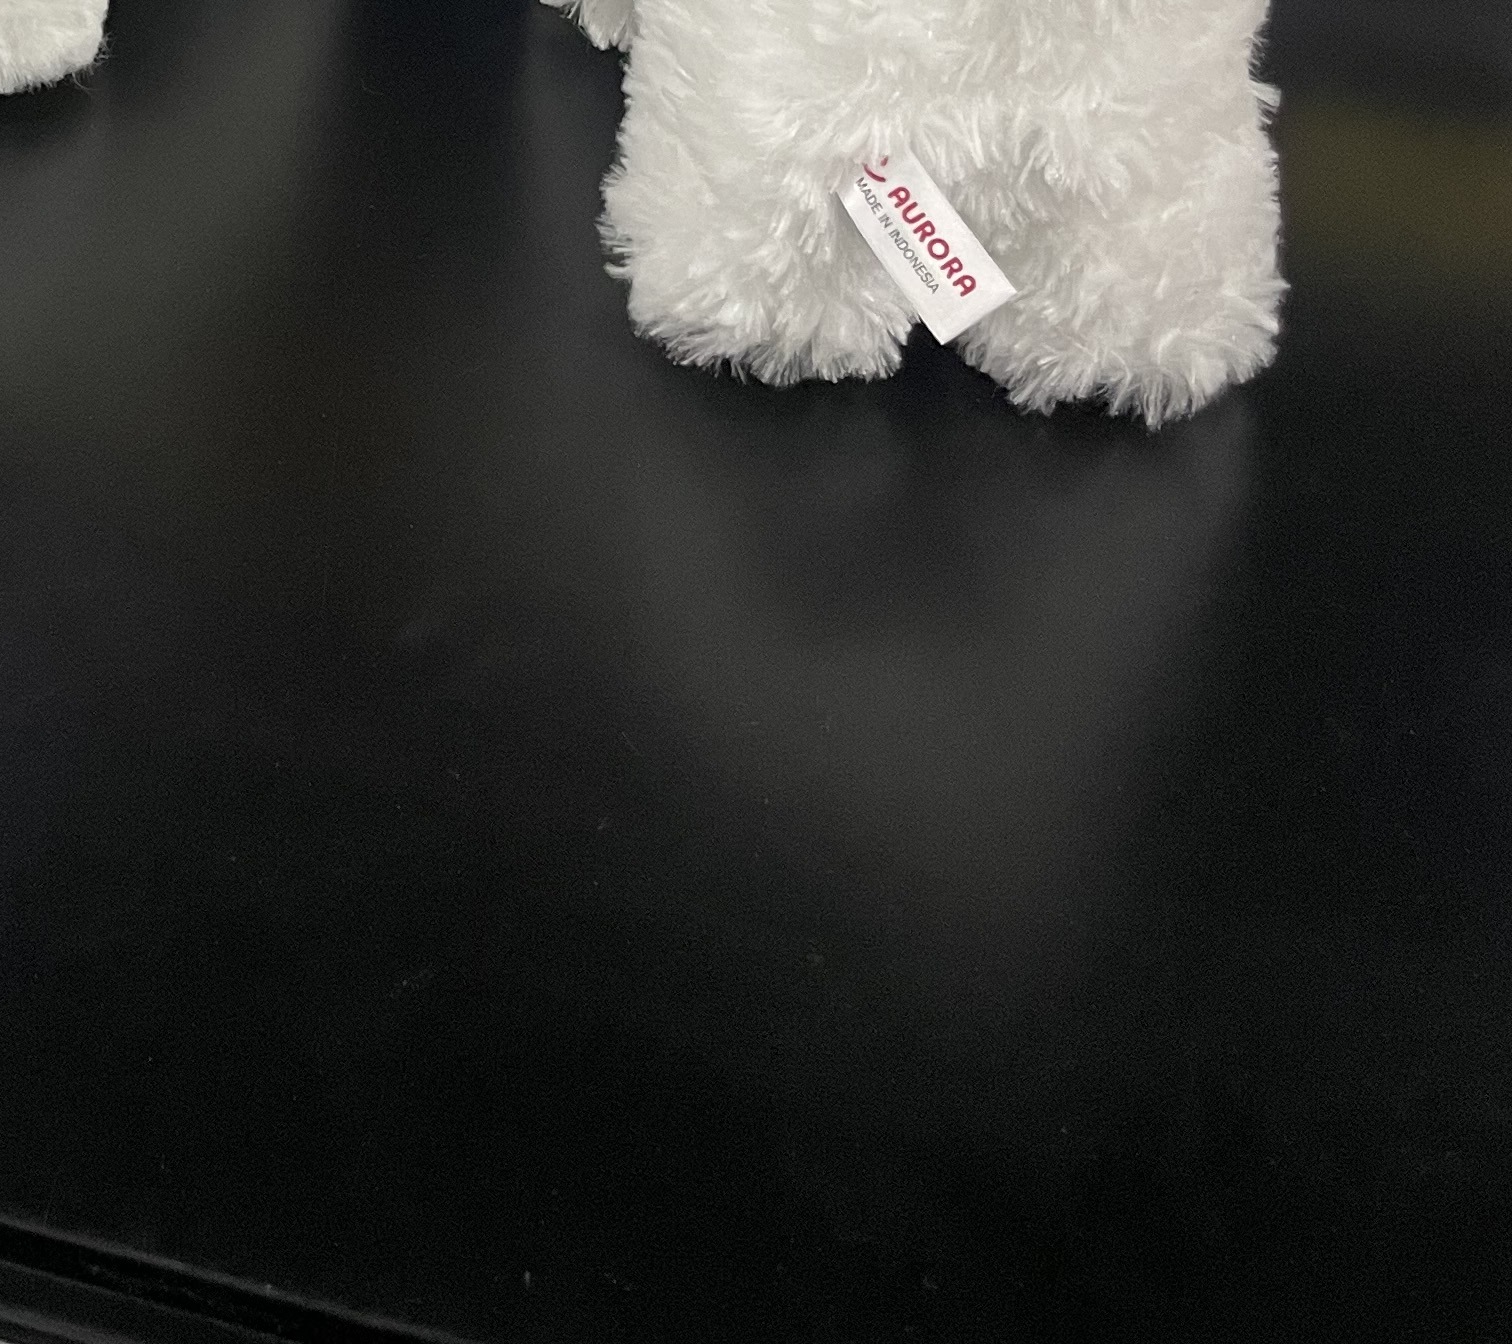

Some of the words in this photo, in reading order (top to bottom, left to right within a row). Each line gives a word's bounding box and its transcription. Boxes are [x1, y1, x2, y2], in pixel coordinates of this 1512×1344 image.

[855, 177, 884, 215] MADE
[878, 213, 893, 229] IN
[889, 228, 940, 295] INDONESIA
[888, 186, 977, 297] AURORA
